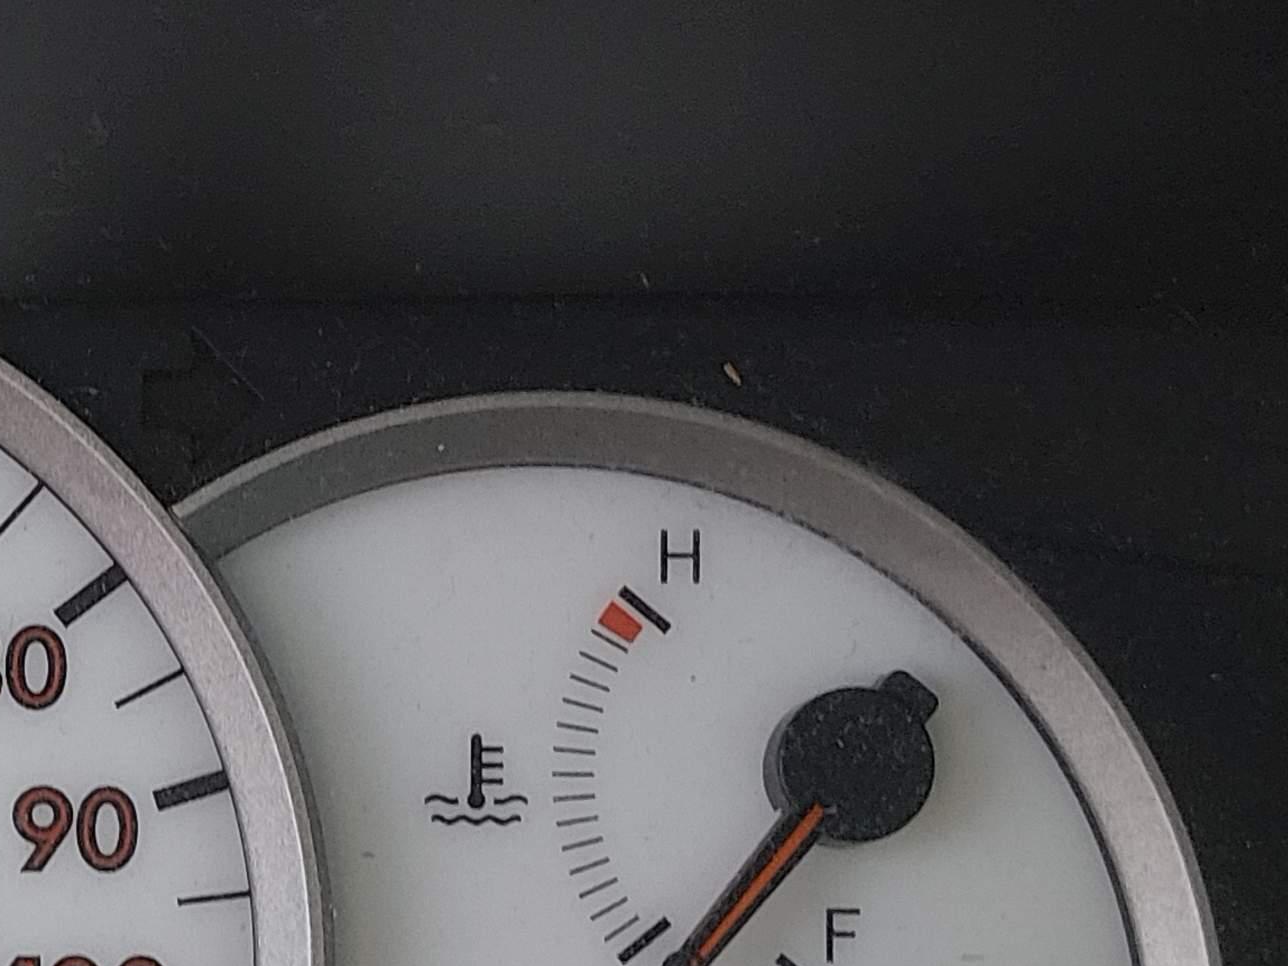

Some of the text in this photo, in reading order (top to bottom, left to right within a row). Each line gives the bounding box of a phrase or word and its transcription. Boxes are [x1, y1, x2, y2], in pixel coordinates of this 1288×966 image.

[661, 530, 700, 584] H
[12, 785, 138, 873] 90
[826, 908, 860, 963] F
